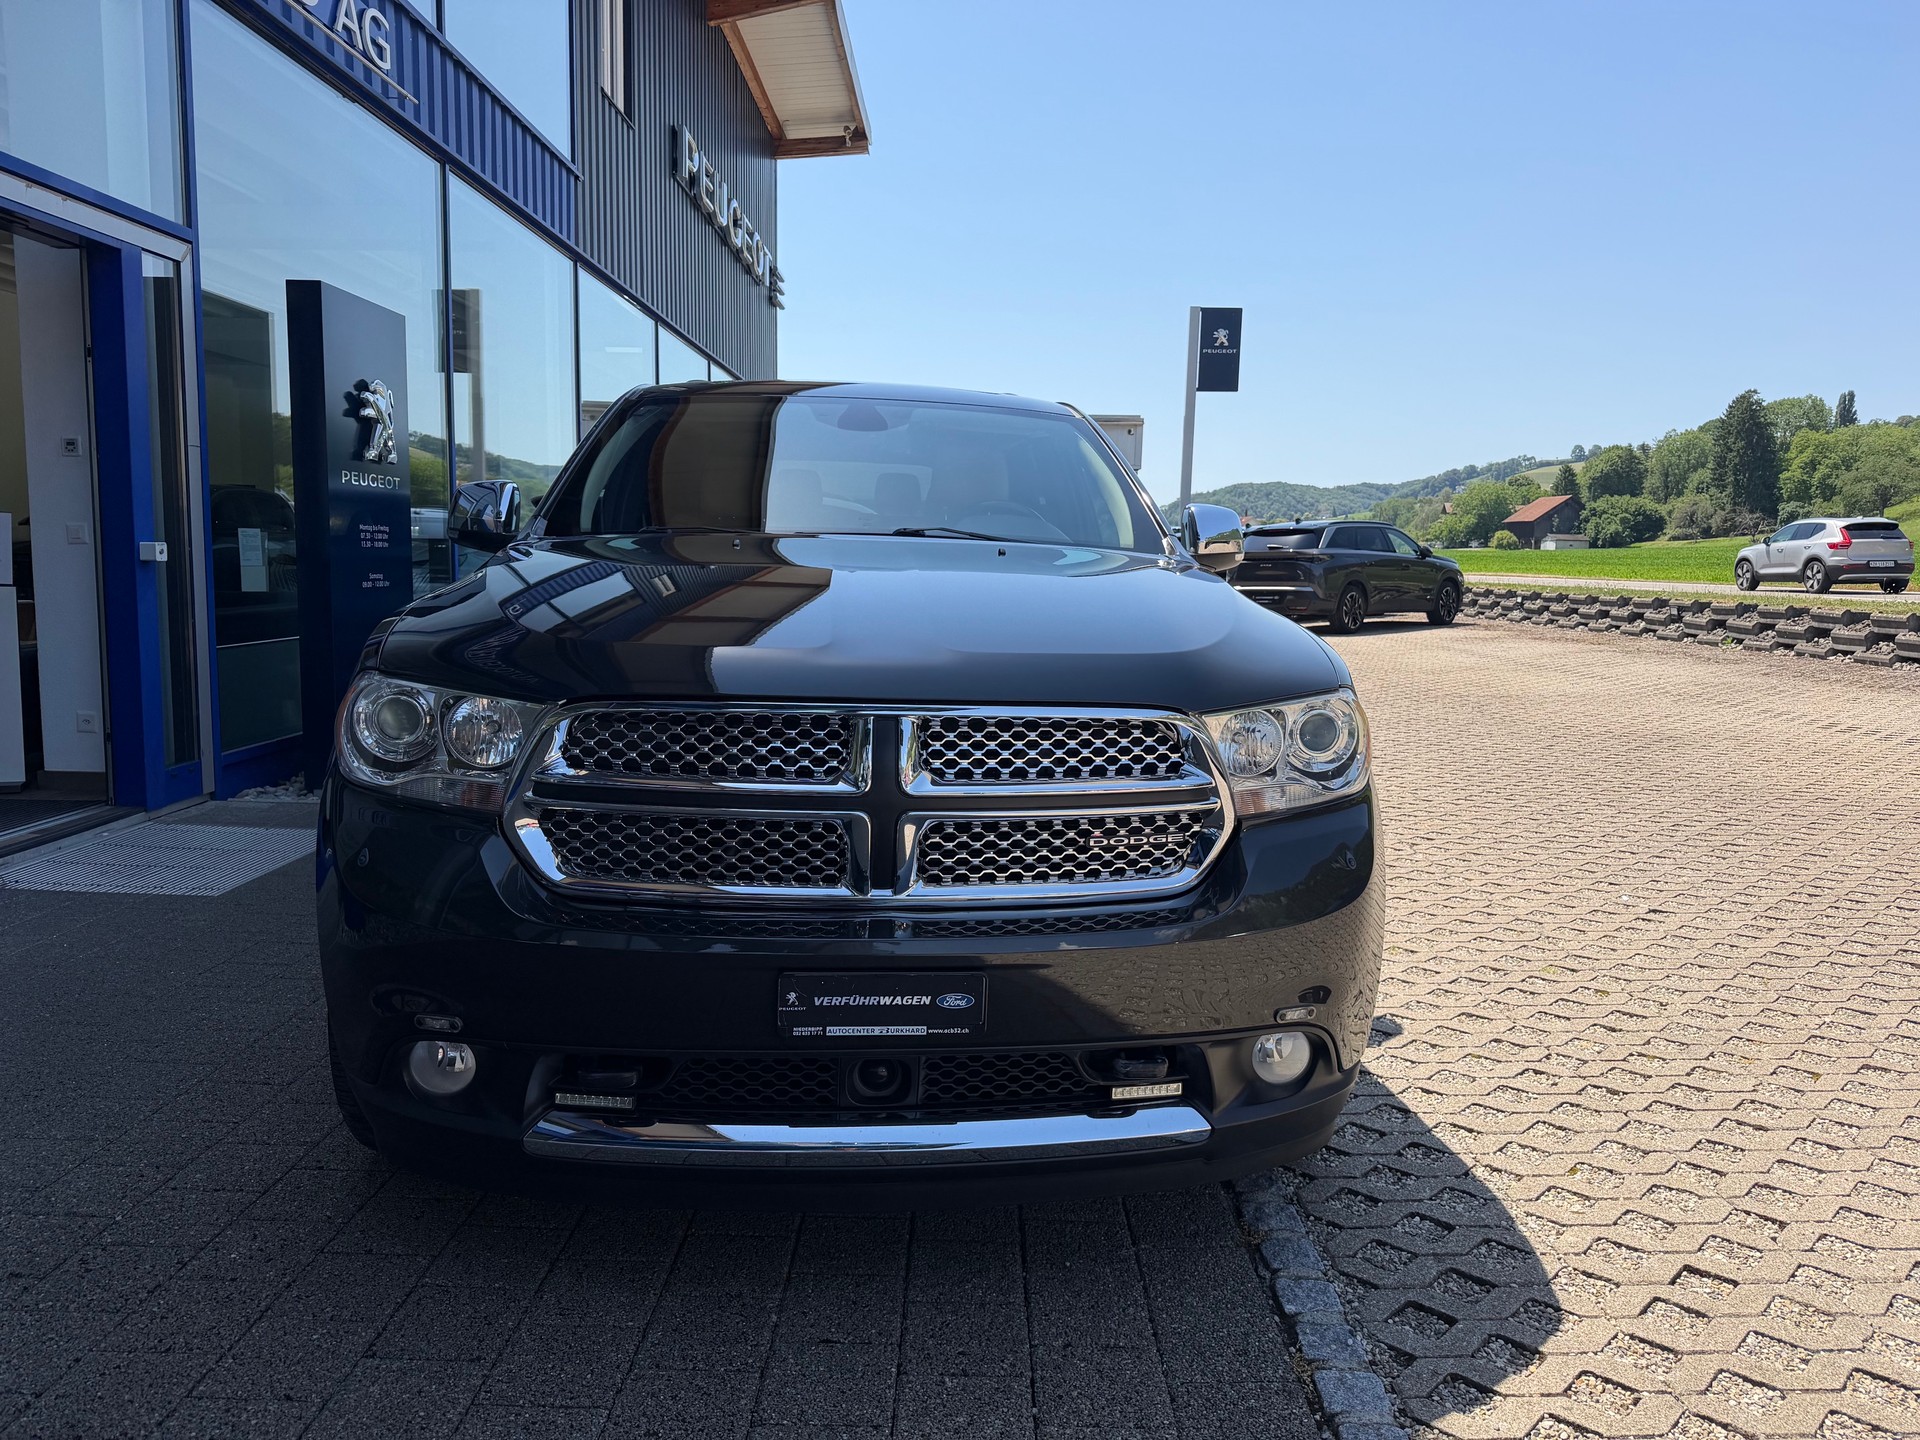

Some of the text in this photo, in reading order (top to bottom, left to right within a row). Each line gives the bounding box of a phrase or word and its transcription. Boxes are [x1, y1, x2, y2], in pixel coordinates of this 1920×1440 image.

[333, 0, 391, 70] AG
[676, 123, 773, 288] PEUGEOT
[341, 470, 401, 490] PEUGEOT
[1090, 834, 1184, 846] DODGE
[814, 995, 931, 1006] VERFÜHRWAGEN
[943, 995, 968, 1007] Ford
[827, 1027, 876, 1035] AUTOCENTER
